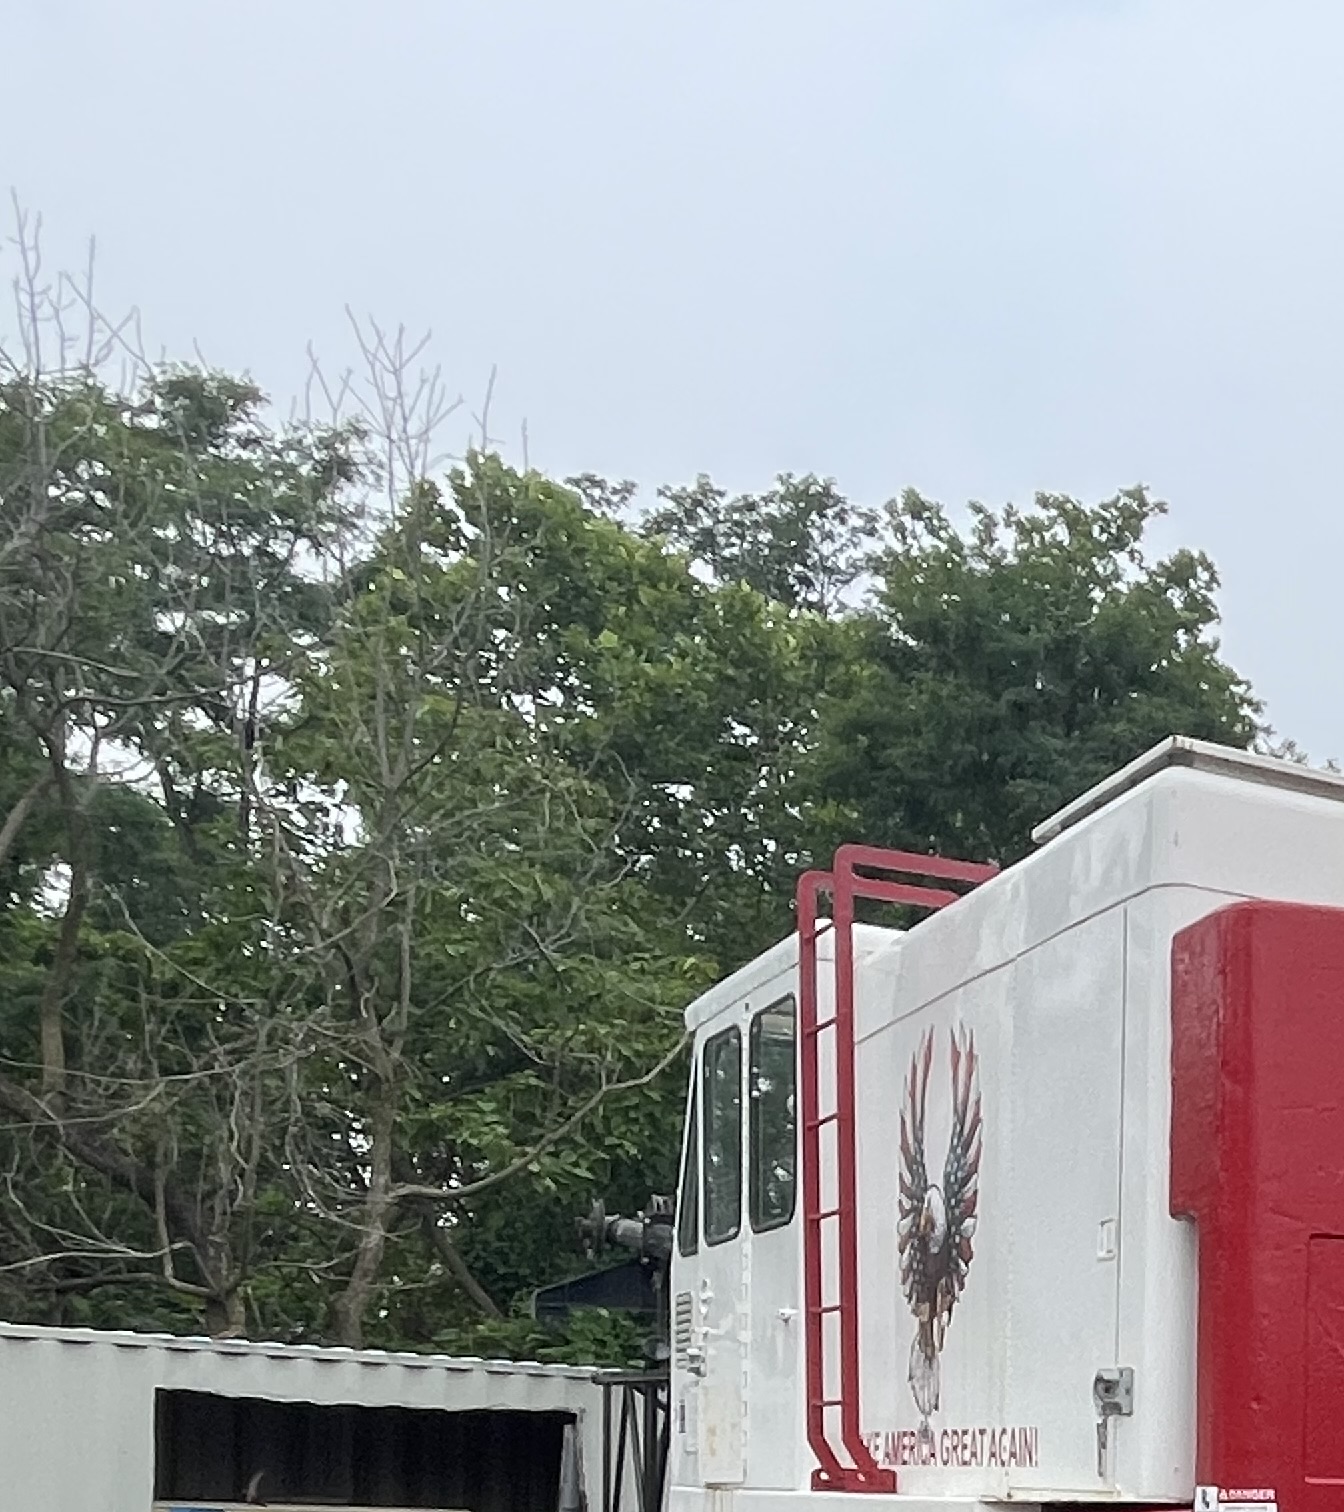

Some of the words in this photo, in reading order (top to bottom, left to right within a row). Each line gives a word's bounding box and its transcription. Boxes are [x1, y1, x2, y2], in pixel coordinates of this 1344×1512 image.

[883, 1431, 937, 1466] AMERICA
[941, 1429, 987, 1467] GREAT
[988, 1427, 1038, 1467] AGAIN!
